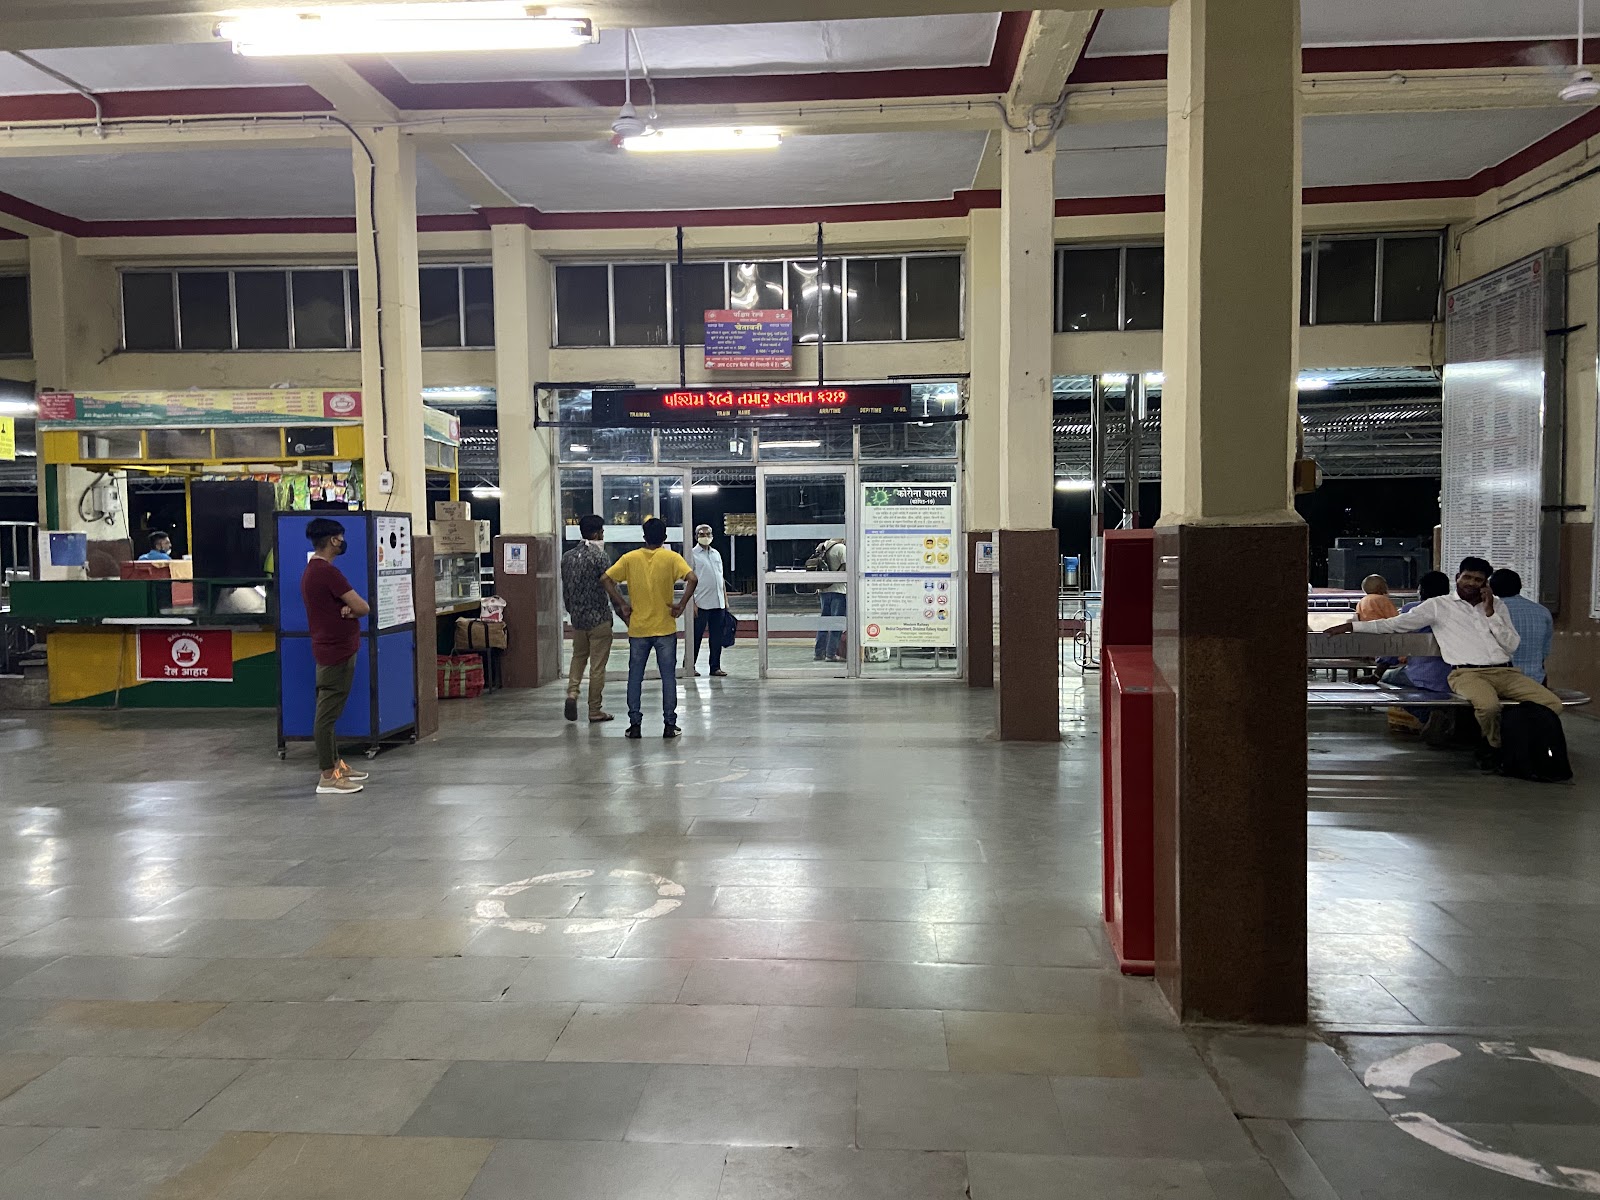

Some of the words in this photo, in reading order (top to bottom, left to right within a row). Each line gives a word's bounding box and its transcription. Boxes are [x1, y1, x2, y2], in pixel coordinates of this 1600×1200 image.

[896, 487, 922, 498] कोरोना
[923, 489, 948, 498] वायरस
[164, 665, 178, 676] रेल
[181, 667, 209, 677] आहार
